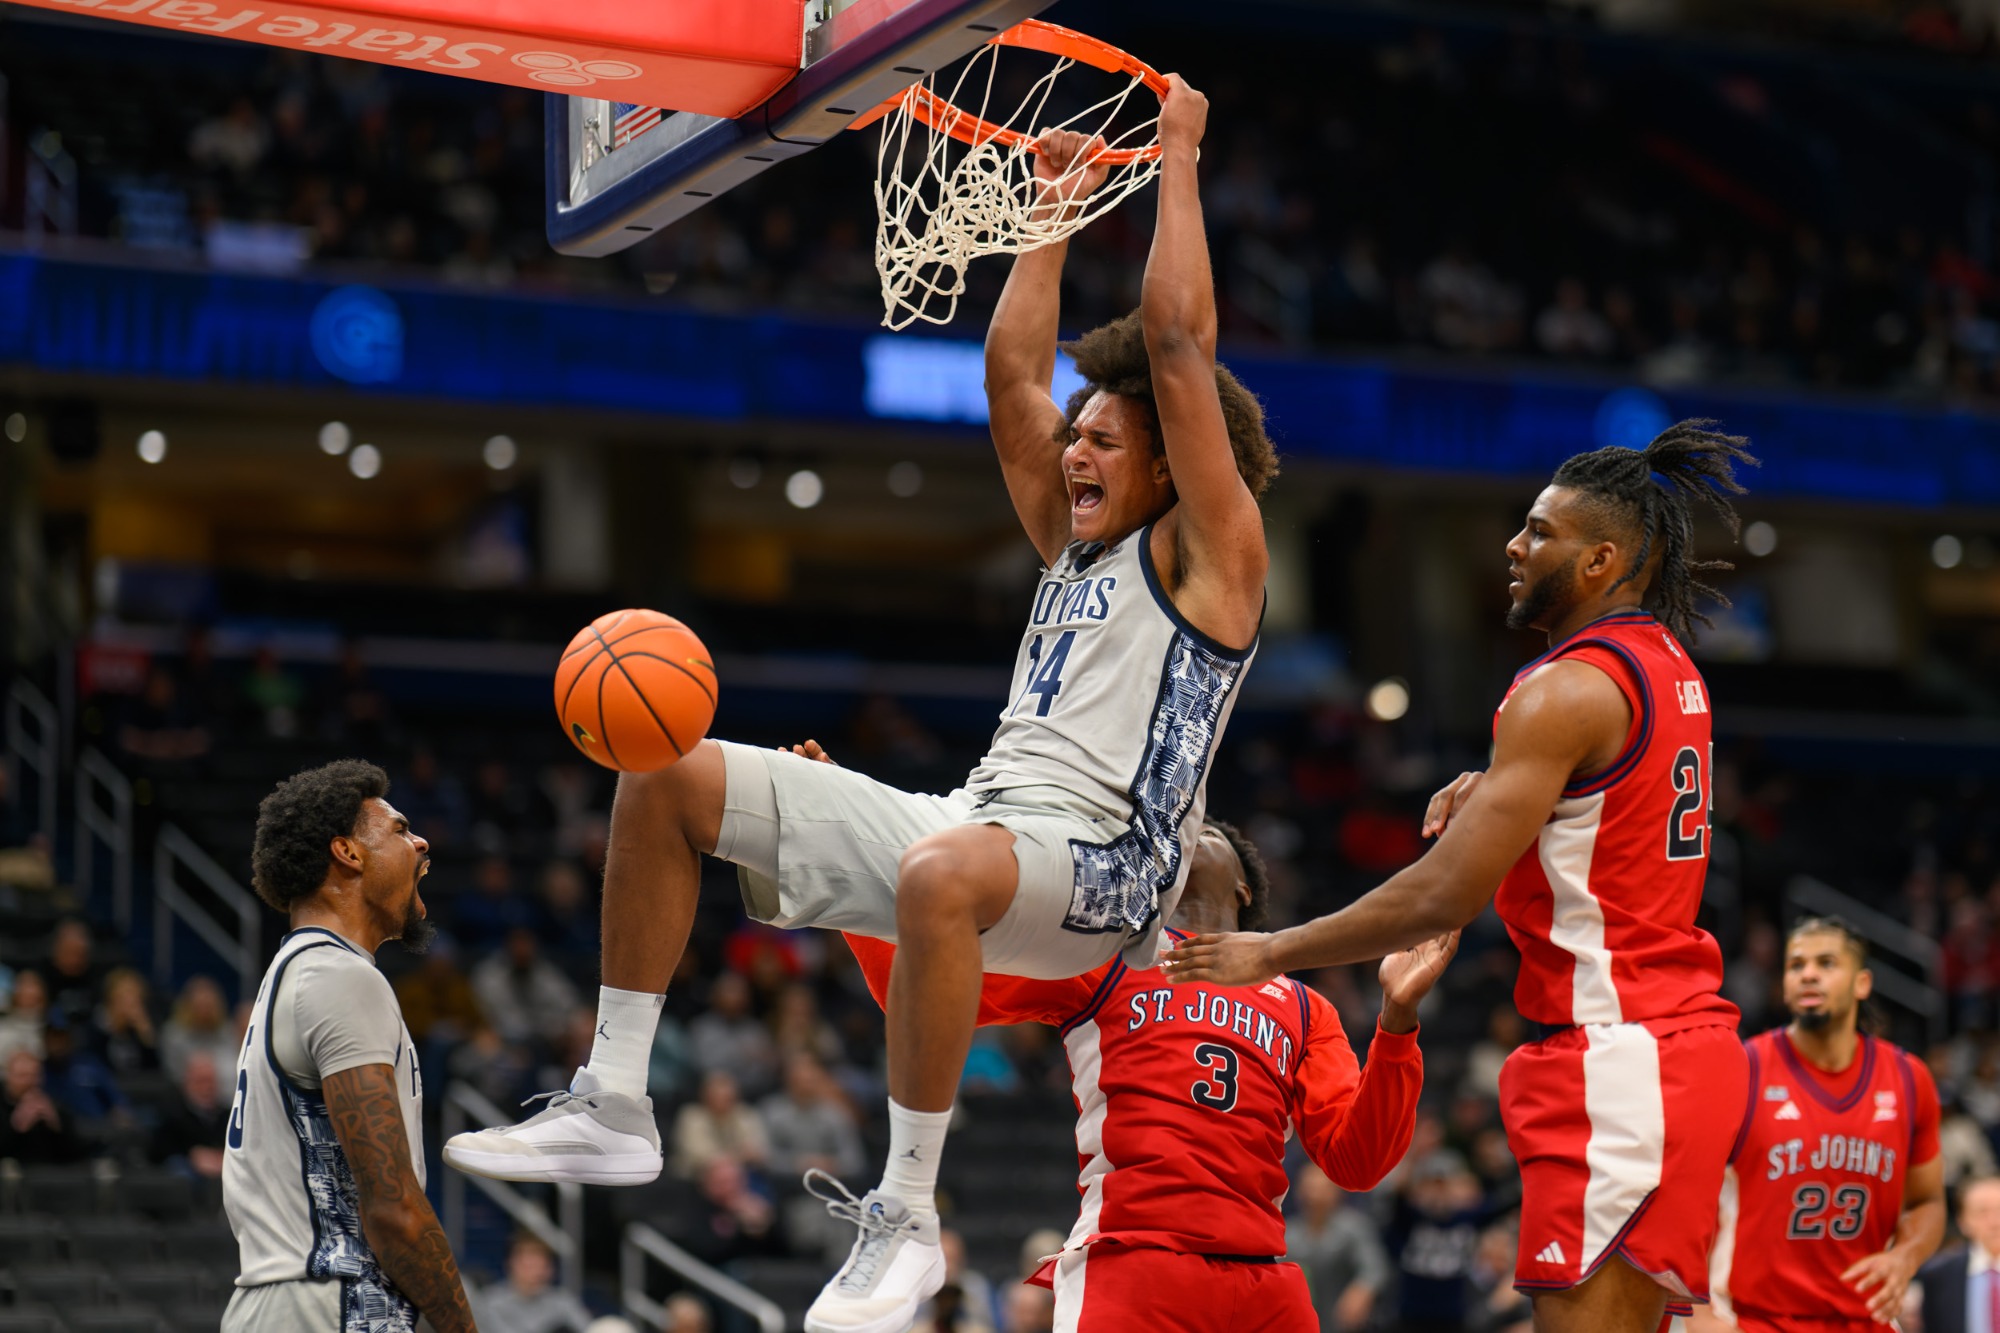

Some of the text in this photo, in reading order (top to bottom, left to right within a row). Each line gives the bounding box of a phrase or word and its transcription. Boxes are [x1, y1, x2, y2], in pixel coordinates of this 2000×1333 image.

[1009, 630, 1077, 718] 14
[1666, 742, 1713, 861] 2
[1128, 988, 1293, 1077] ST. JOHN'S
[1191, 1041, 1238, 1113] 3
[1767, 1133, 1896, 1182] ST. JOHN'S
[1786, 1181, 1871, 1240] 23
